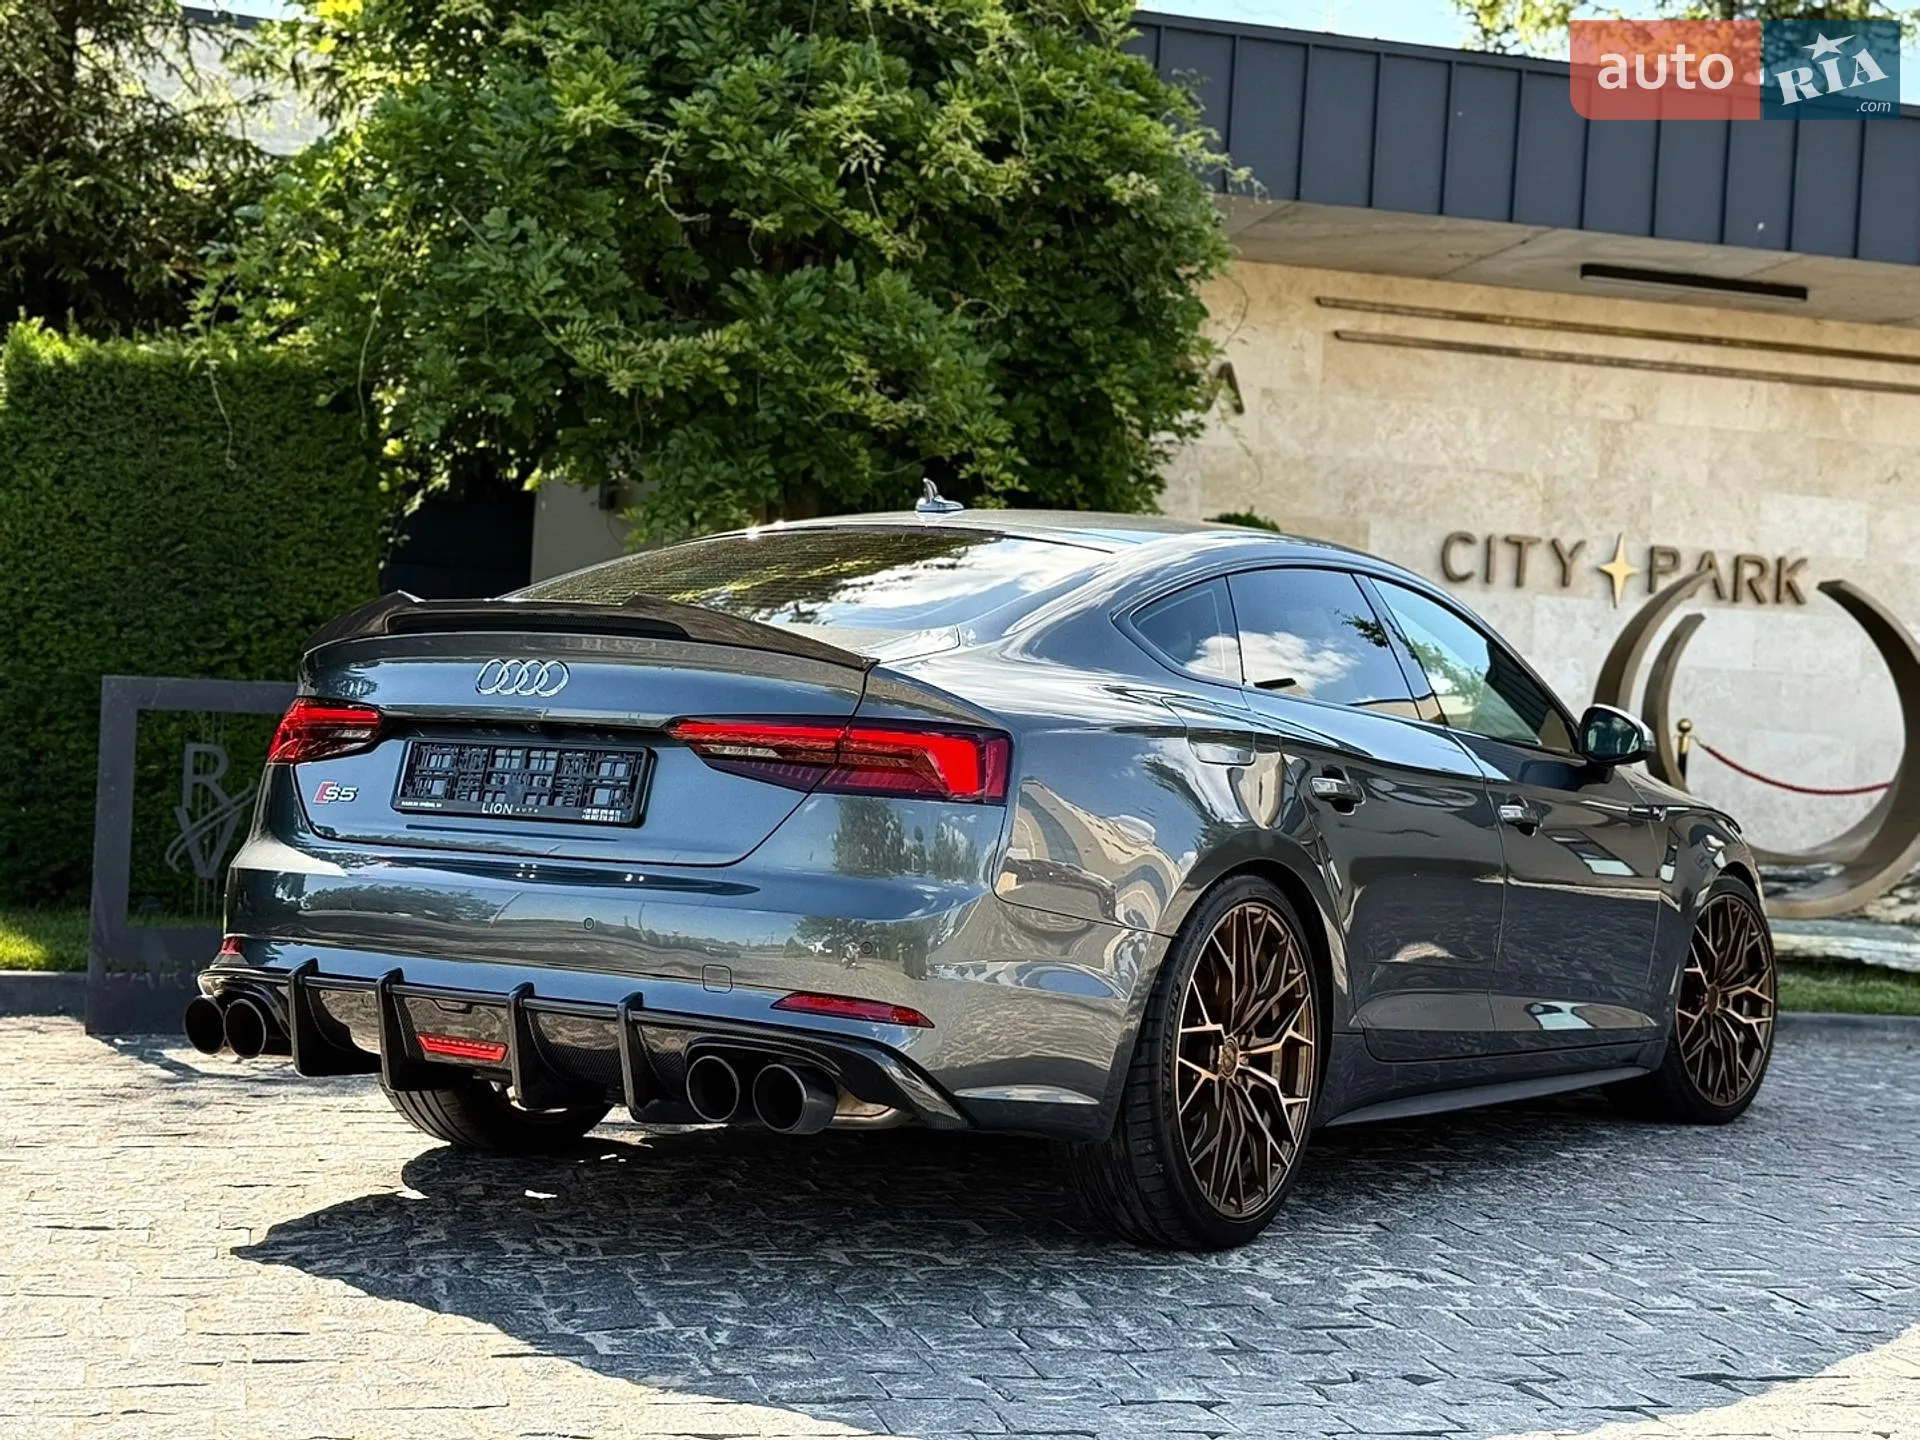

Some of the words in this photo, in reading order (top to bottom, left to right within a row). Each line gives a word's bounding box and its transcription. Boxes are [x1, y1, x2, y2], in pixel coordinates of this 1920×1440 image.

[1441, 530, 1586, 588] CITY
[1648, 546, 1808, 606] PARK
[320, 784, 358, 802] S5
[481, 802, 514, 815] LION
